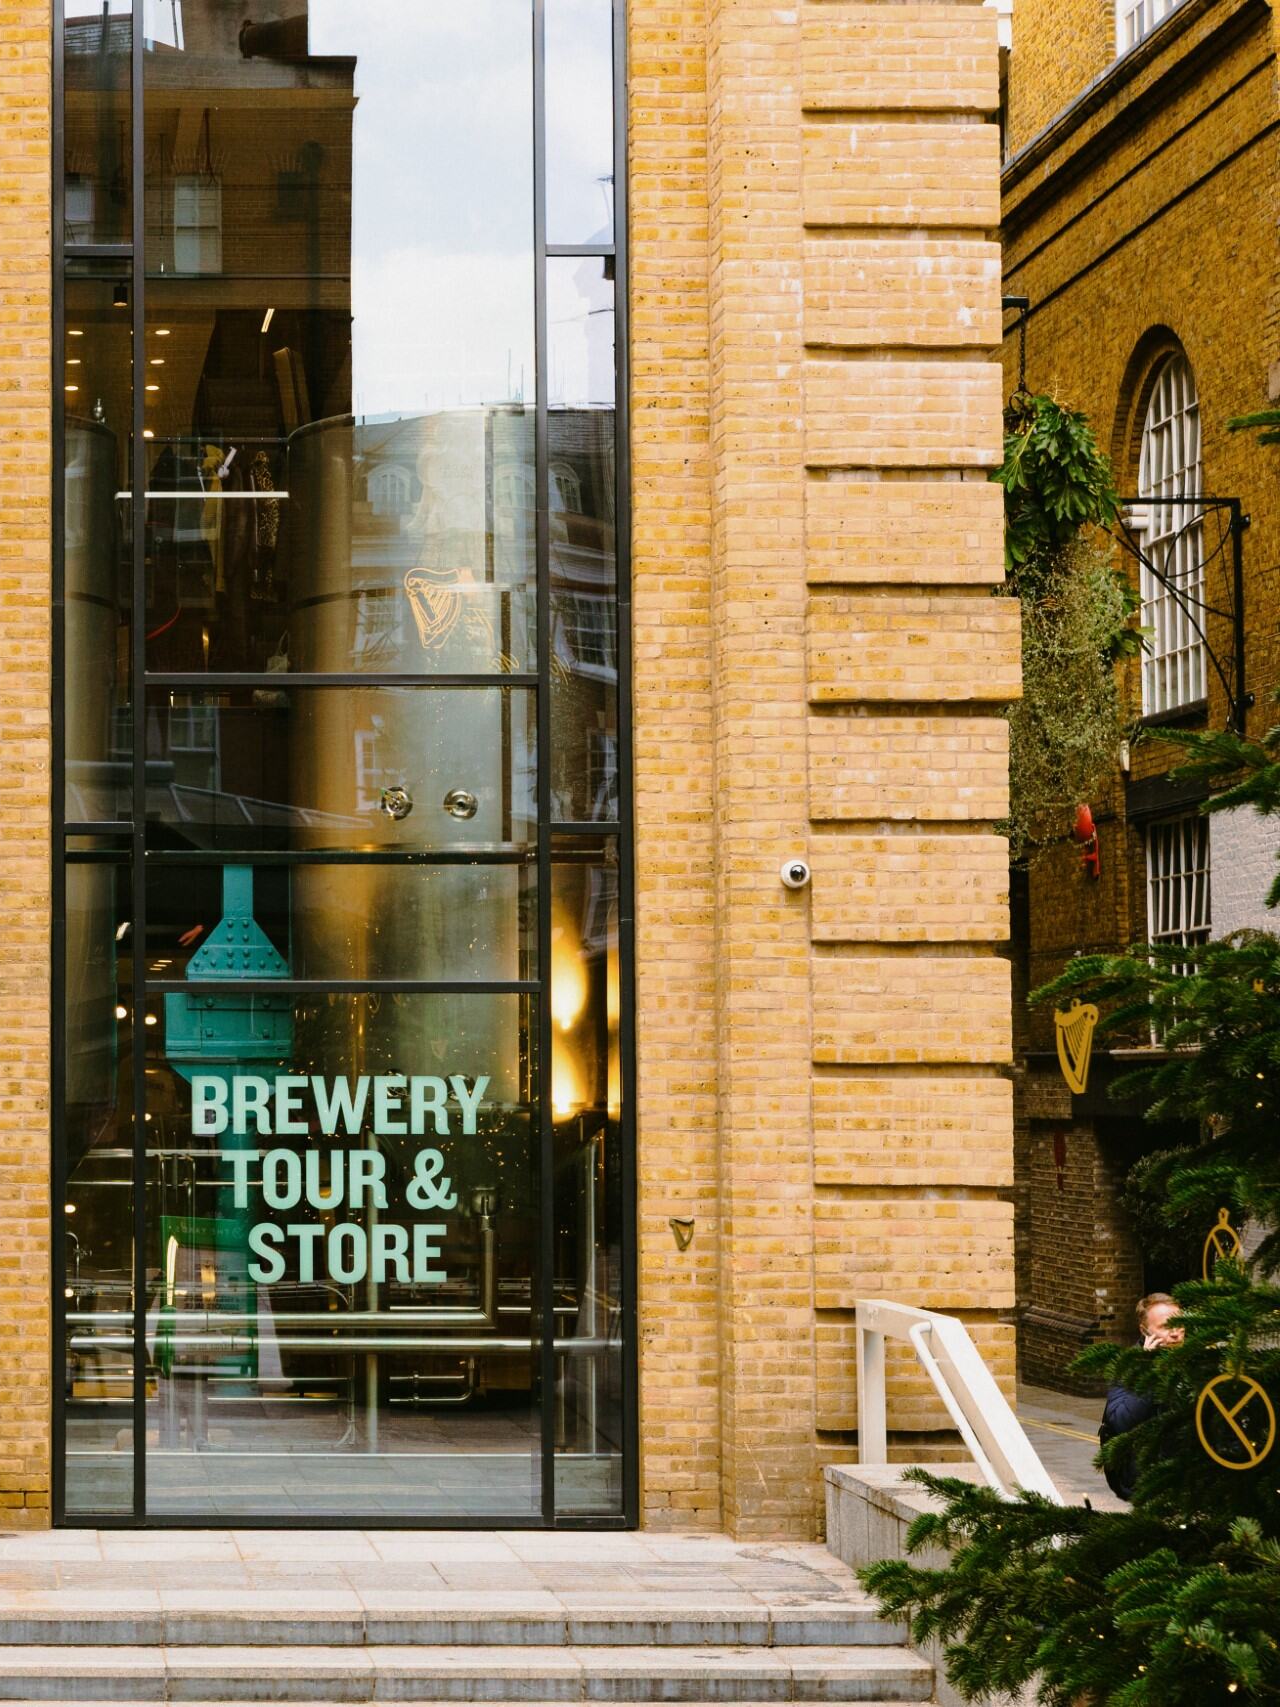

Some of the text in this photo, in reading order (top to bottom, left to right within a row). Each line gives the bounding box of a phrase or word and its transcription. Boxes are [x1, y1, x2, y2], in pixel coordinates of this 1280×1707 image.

[191, 1075, 491, 1135] BREWERY
[221, 1148, 458, 1210] TOUR &
[247, 1223, 447, 1284] STORE
